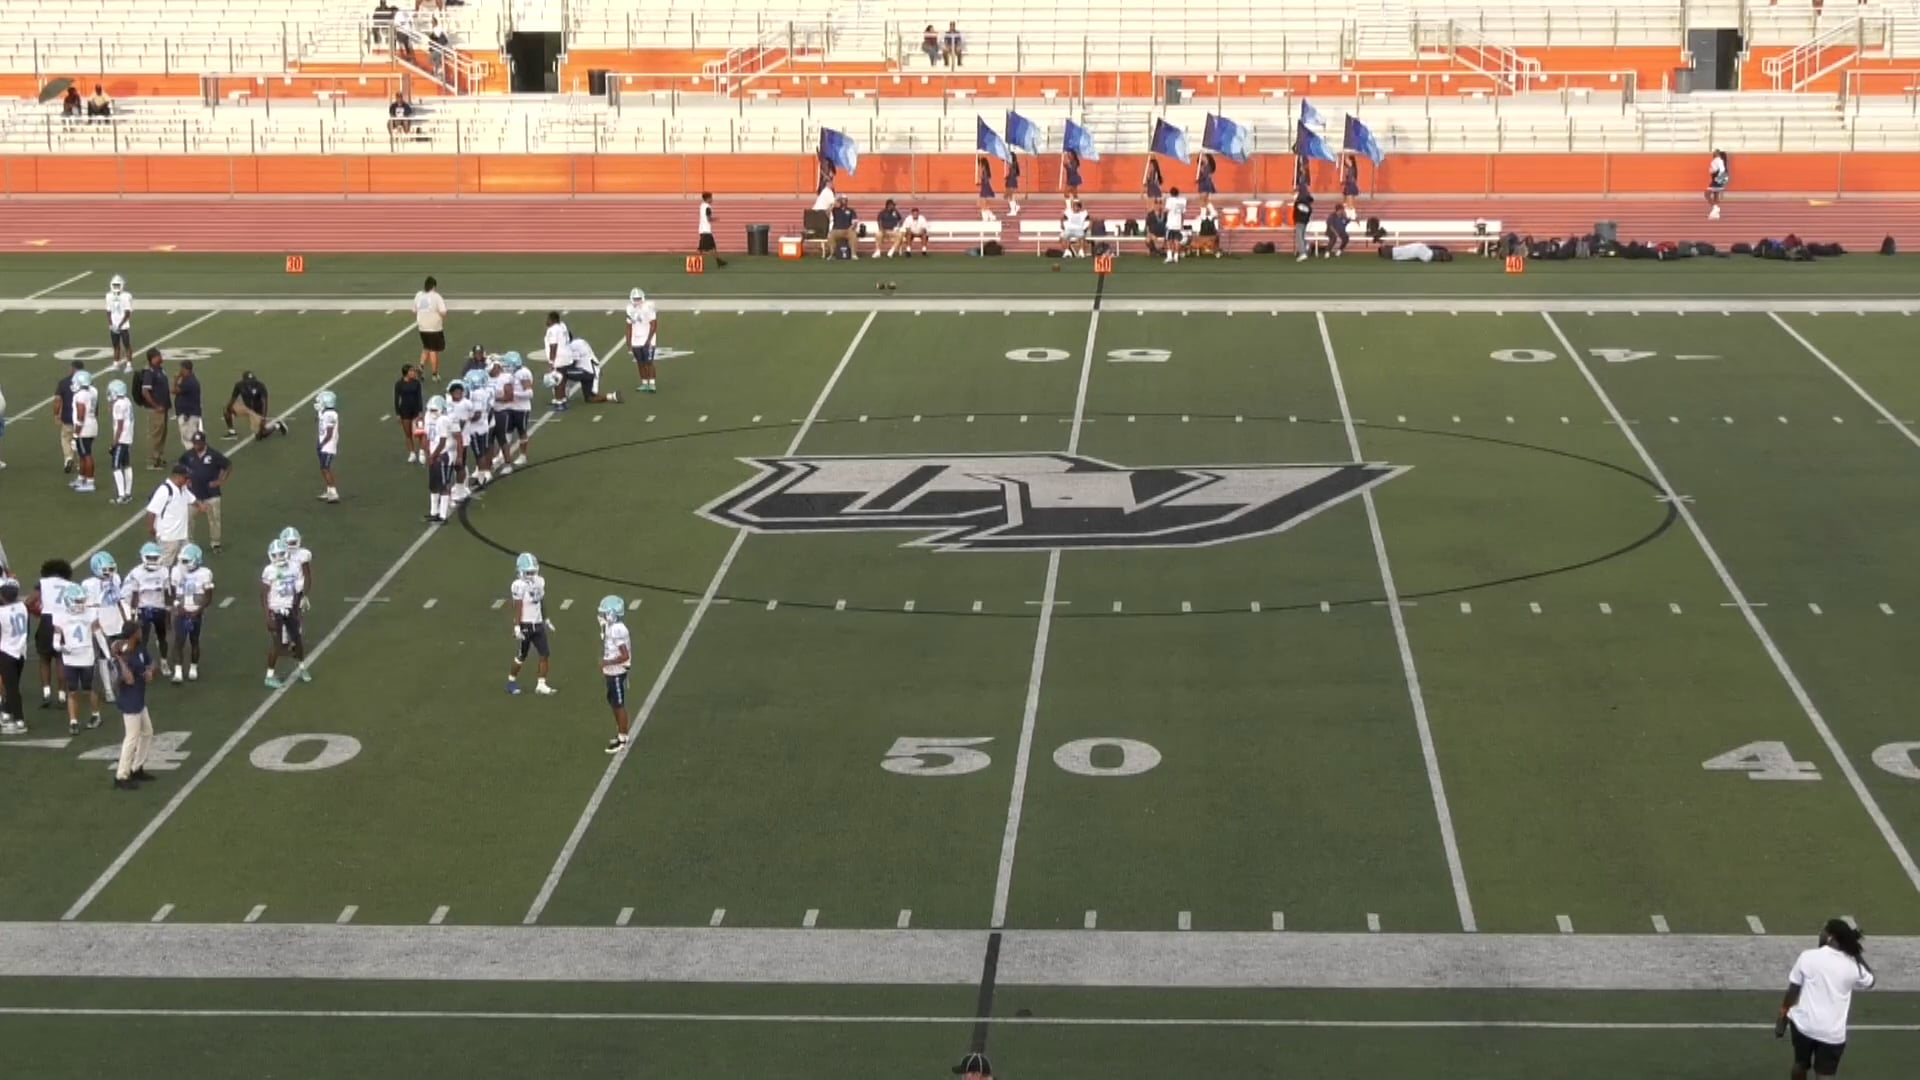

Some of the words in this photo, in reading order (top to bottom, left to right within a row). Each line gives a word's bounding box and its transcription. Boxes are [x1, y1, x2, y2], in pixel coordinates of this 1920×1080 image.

[1507, 256, 1522, 272] 40
[10, 612, 26, 638] 10
[72, 625, 84, 643] 4
